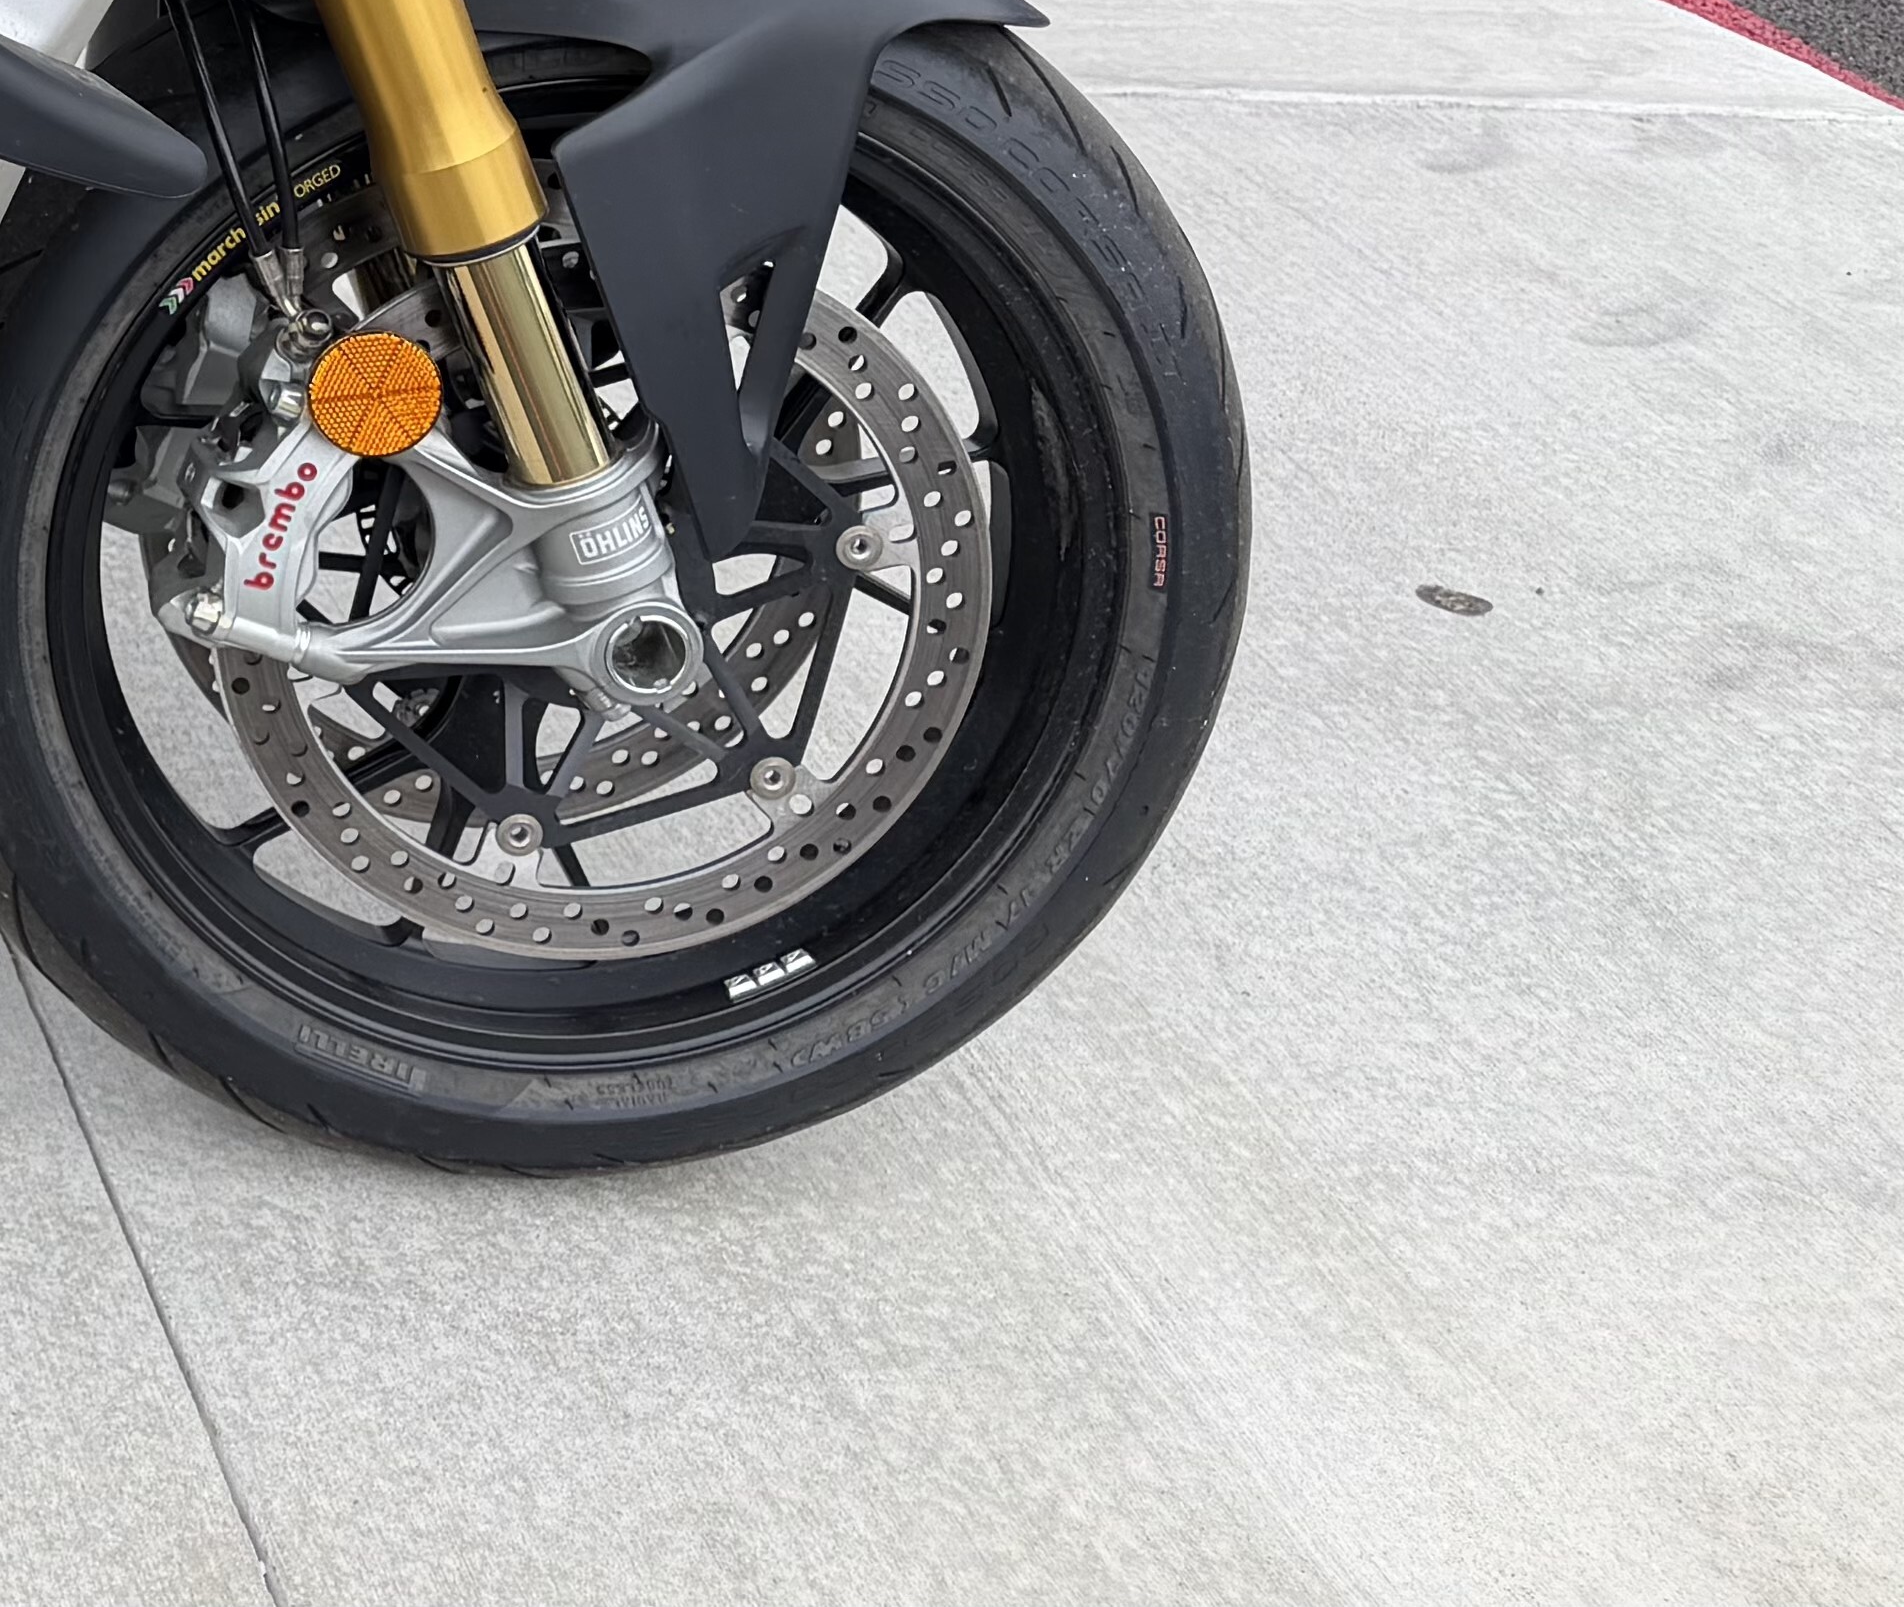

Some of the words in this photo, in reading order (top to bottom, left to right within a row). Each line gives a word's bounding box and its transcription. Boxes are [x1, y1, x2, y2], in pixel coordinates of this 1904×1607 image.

[191, 200, 281, 282] marchsin
[293, 163, 341, 199] ORGED
[243, 462, 318, 591] brembo
[578, 505, 650, 559] ÖHLINS
[1150, 515, 1168, 588] CORSA
[1085, 666, 1159, 806] 120/70
